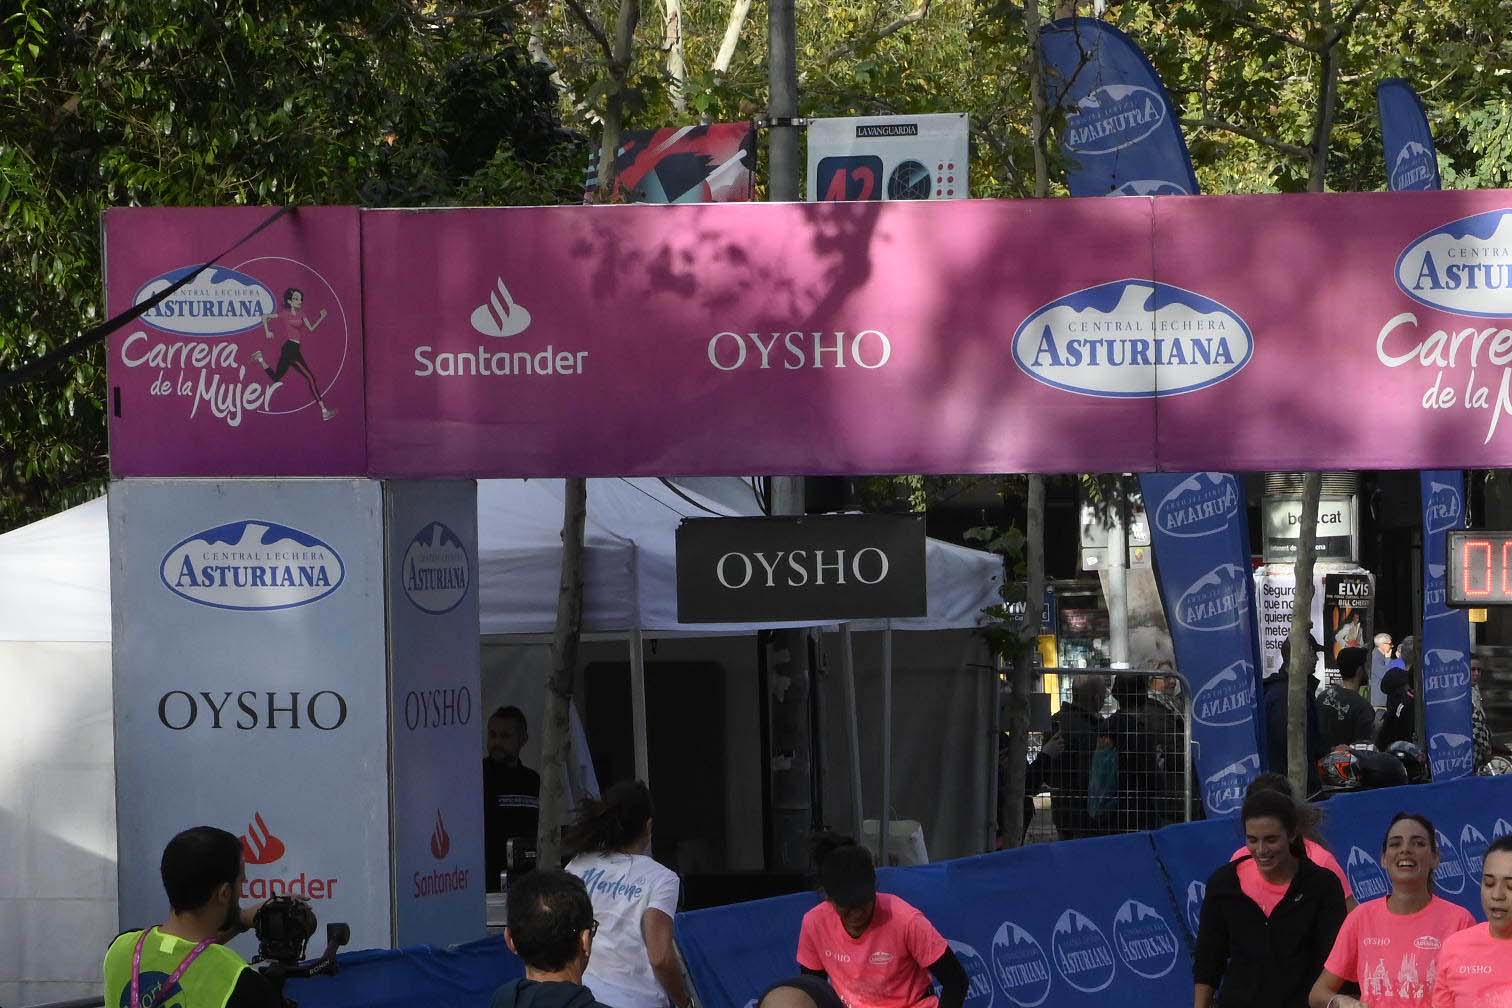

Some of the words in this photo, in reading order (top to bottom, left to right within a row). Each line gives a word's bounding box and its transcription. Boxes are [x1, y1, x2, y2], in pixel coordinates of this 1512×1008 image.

[144, 291, 264, 318] ASTURIANA
[173, 288, 210, 297] ENTRAL
[1068, 320, 1144, 333] CENTRAL
[1151, 318, 1227, 332] LECHERA
[121, 331, 239, 369] Carrera
[414, 344, 589, 376] Santander
[707, 330, 891, 371] OYSHO
[1031, 324, 1235, 367] ASTURIANA
[151, 370, 172, 396] de
[177, 370, 193, 396] la
[190, 364, 284, 427] Mujer
[1422, 370, 1456, 409] de
[1464, 370, 1490, 409] la
[1288, 511, 1342, 526] b.cat
[175, 555, 331, 588] ASTURIANA
[203, 551, 261, 561] CENTRAL
[264, 551, 325, 561] LECHERA
[716, 547, 889, 589] OYSHO
[408, 557, 466, 591] ASTURIANA
[1338, 583, 1369, 596] ELVIS
[1263, 600, 1281, 611] que
[158, 690, 348, 730] OYSHO
[405, 686, 471, 731] OYSHO
[239, 873, 338, 900] tander
[413, 867, 470, 898] Santander
[581, 867, 642, 902] Marlene
[997, 957, 1048, 989] ASTURIANA
[1057, 942, 1112, 974] ASTURIANA
